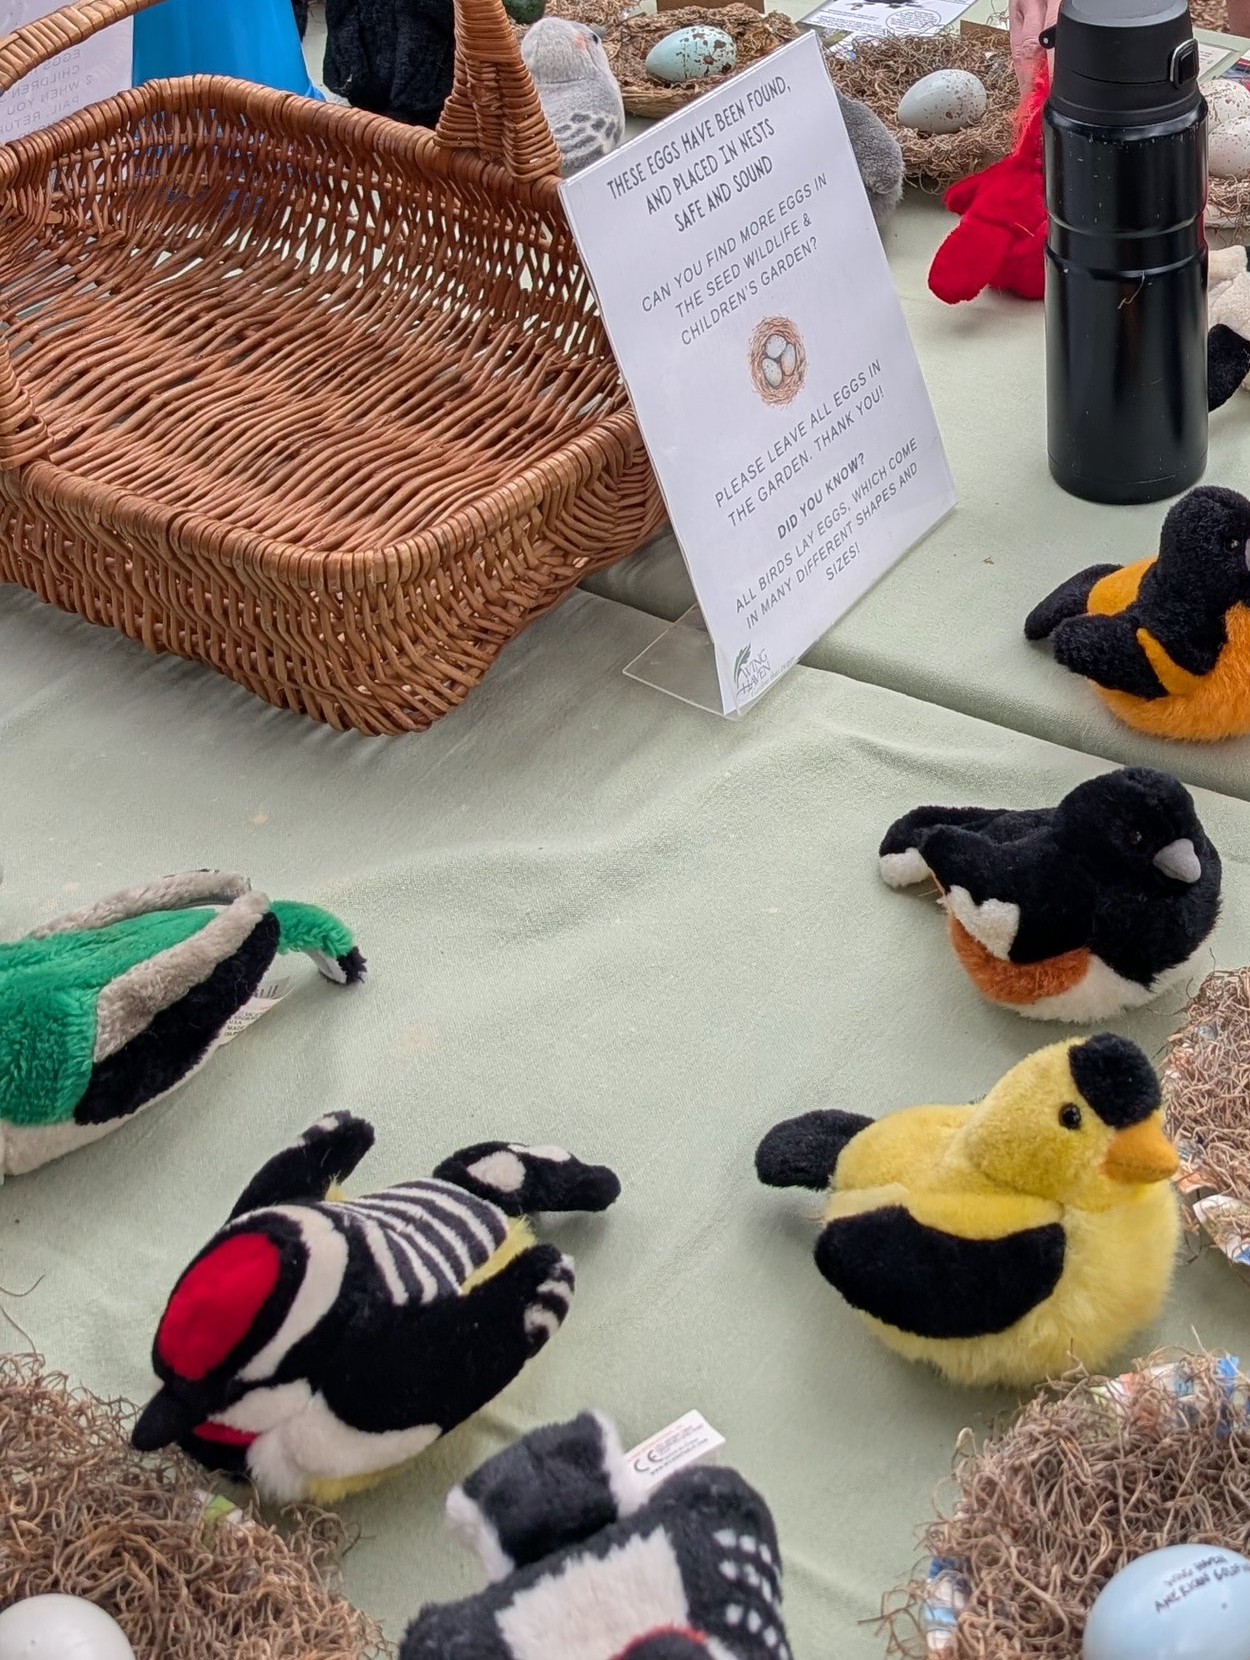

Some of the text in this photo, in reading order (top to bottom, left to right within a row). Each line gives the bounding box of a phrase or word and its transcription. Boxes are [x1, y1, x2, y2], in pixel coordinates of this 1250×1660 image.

[606, 76, 792, 199] THESE EGGS HAVE BEEN FOUND,
[645, 118, 775, 215] AND PLACED IN NESTS
[674, 155, 773, 233] SAFE AND SOUND
[642, 173, 828, 312] CAN YOU FIND MORE EGGS IN
[675, 213, 812, 318] THE SEED WILDLIFE &
[681, 236, 818, 345] CHILDREN'S GARDEN?
[714, 359, 882, 508] PLEASE LEAVE ALL EGGS IN
[728, 384, 885, 527] THE GARDEN. THANK YOU!
[735, 438, 918, 613] ALL BIRDS LAY EGGS, WHICH COME
[747, 462, 918, 630] IN MANY DIFFERENT SHAPES AND
[777, 452, 865, 539] DID YOU KNOW?
[825, 542, 861, 581] SIZES!
